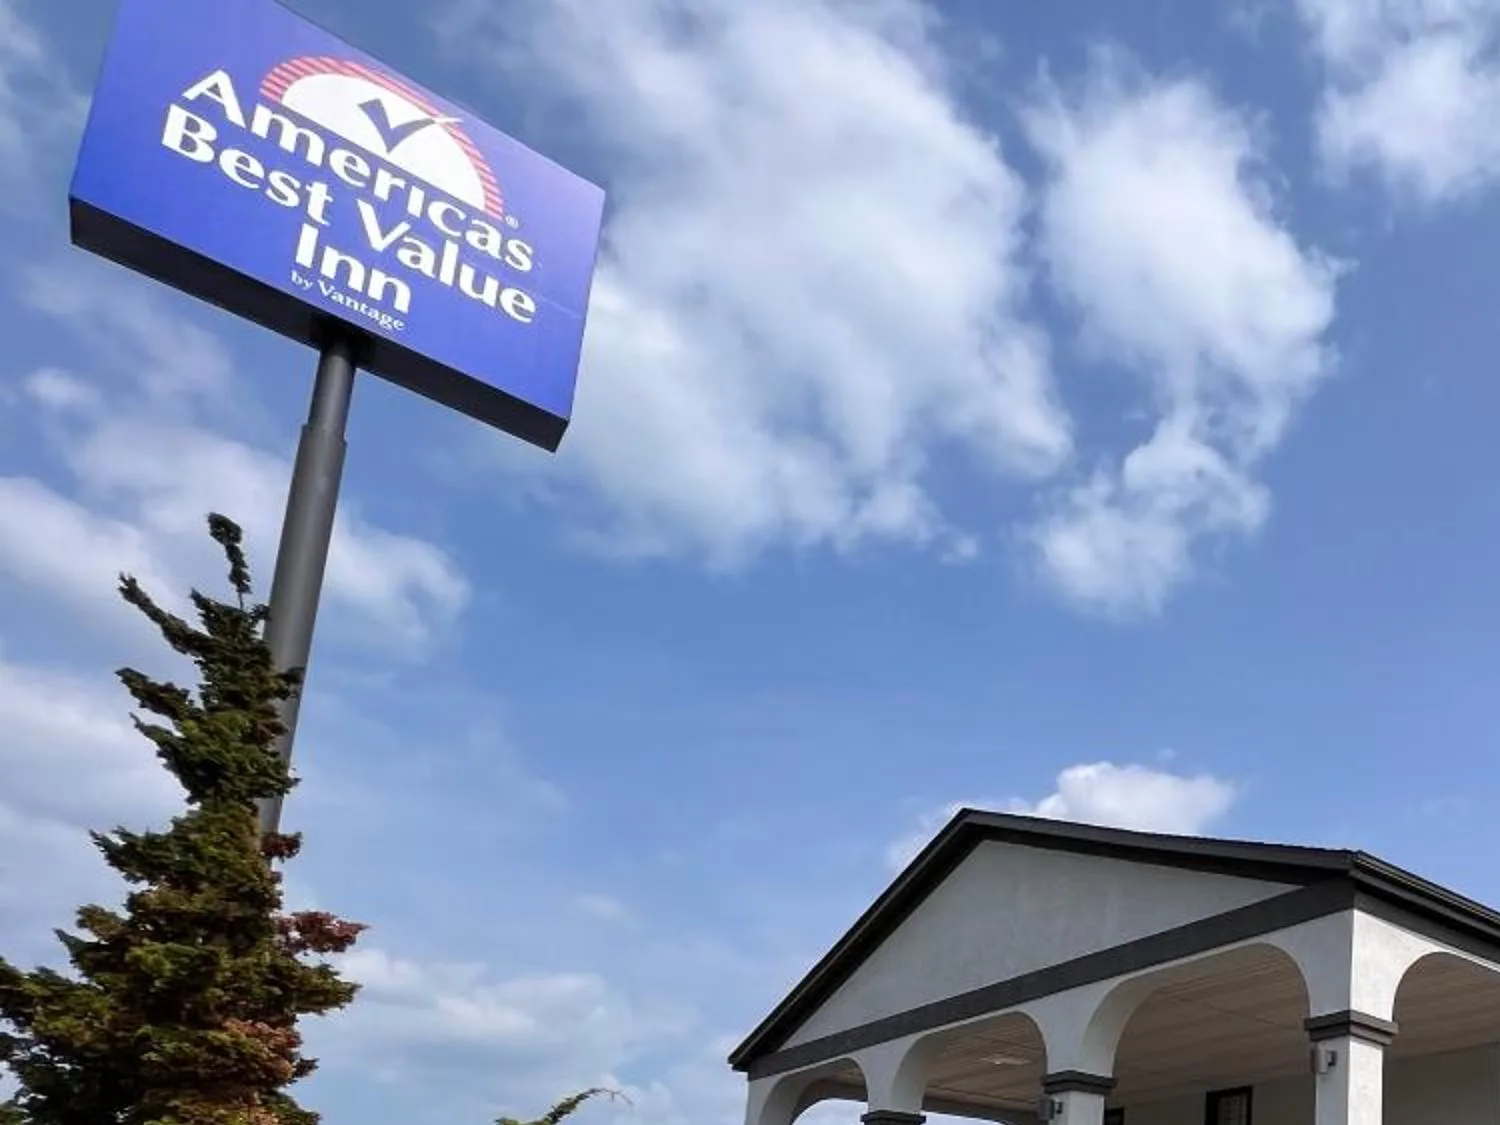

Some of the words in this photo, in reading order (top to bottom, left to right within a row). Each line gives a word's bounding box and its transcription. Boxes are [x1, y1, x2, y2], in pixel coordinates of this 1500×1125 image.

[160, 104, 333, 226] Best
[354, 198, 536, 324] Value
[182, 69, 534, 273] Americas
[291, 269, 313, 290] by
[317, 279, 405, 331] Vantage
[294, 223, 411, 314] Inn
